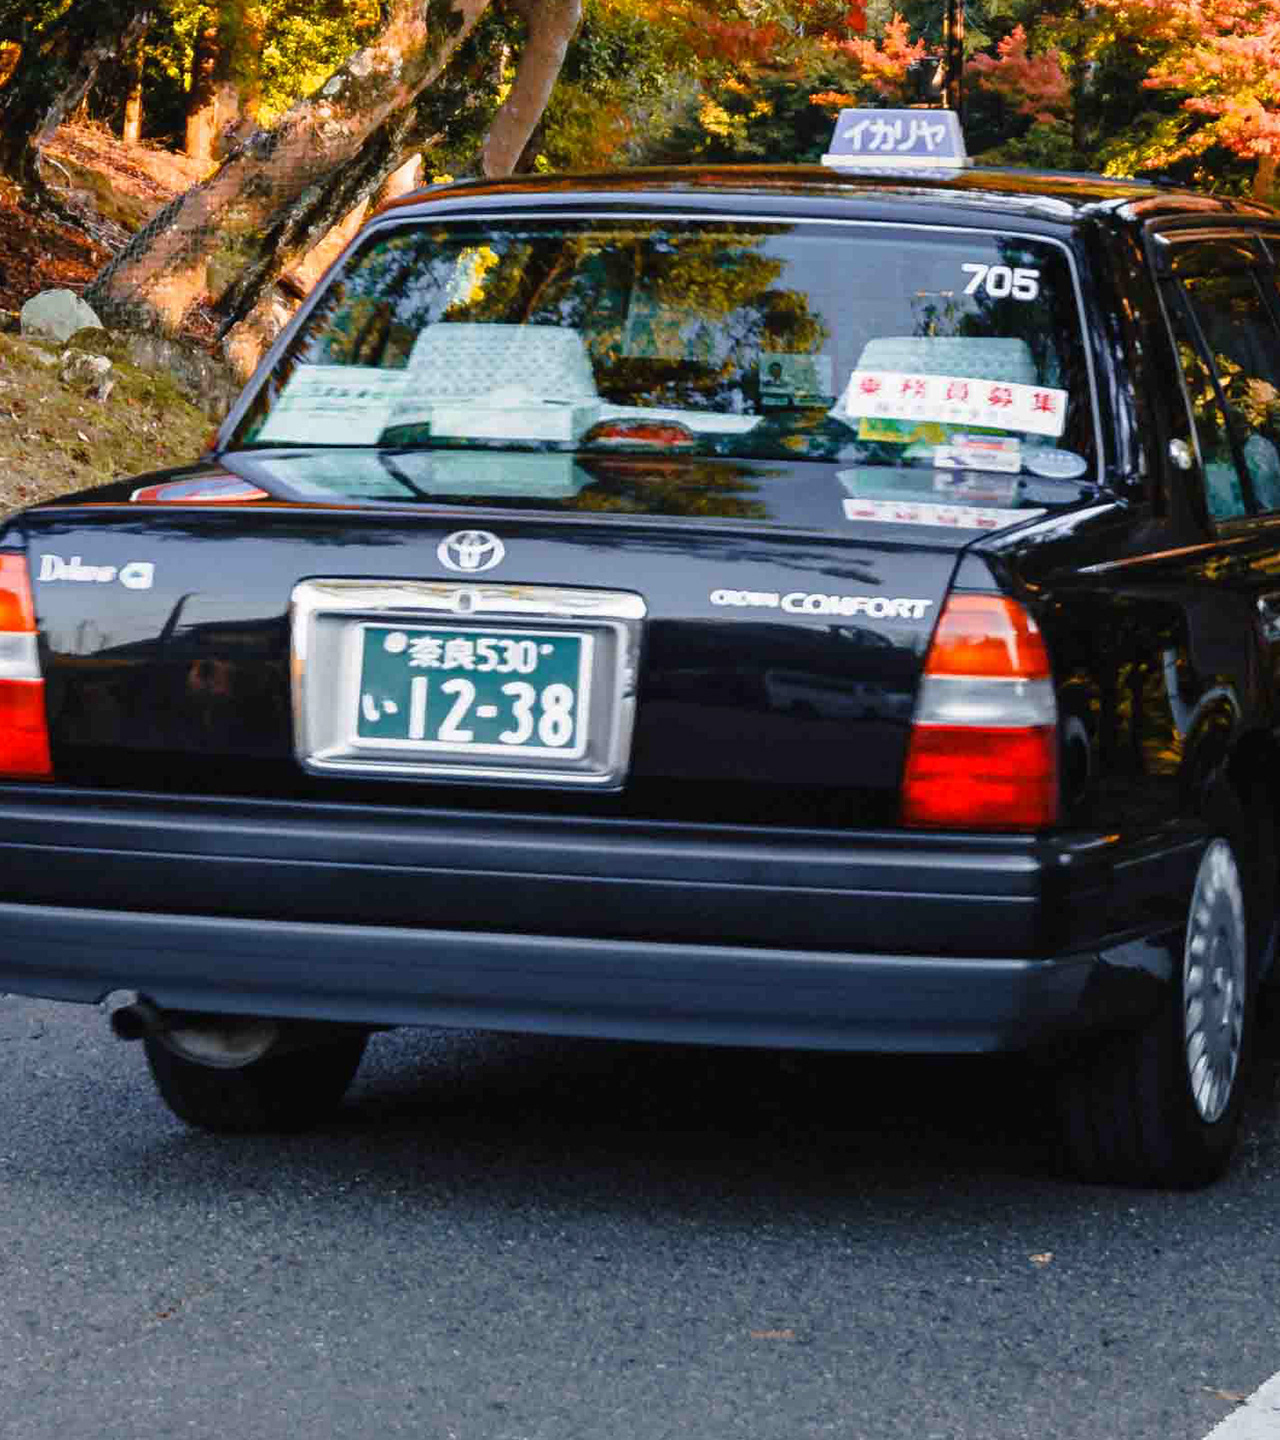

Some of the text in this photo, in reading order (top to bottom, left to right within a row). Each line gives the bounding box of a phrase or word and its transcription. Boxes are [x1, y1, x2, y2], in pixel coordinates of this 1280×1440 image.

[842, 118, 946, 151] イカリヤ
[961, 263, 1040, 302] 705
[408, 675, 575, 747] 12-38
